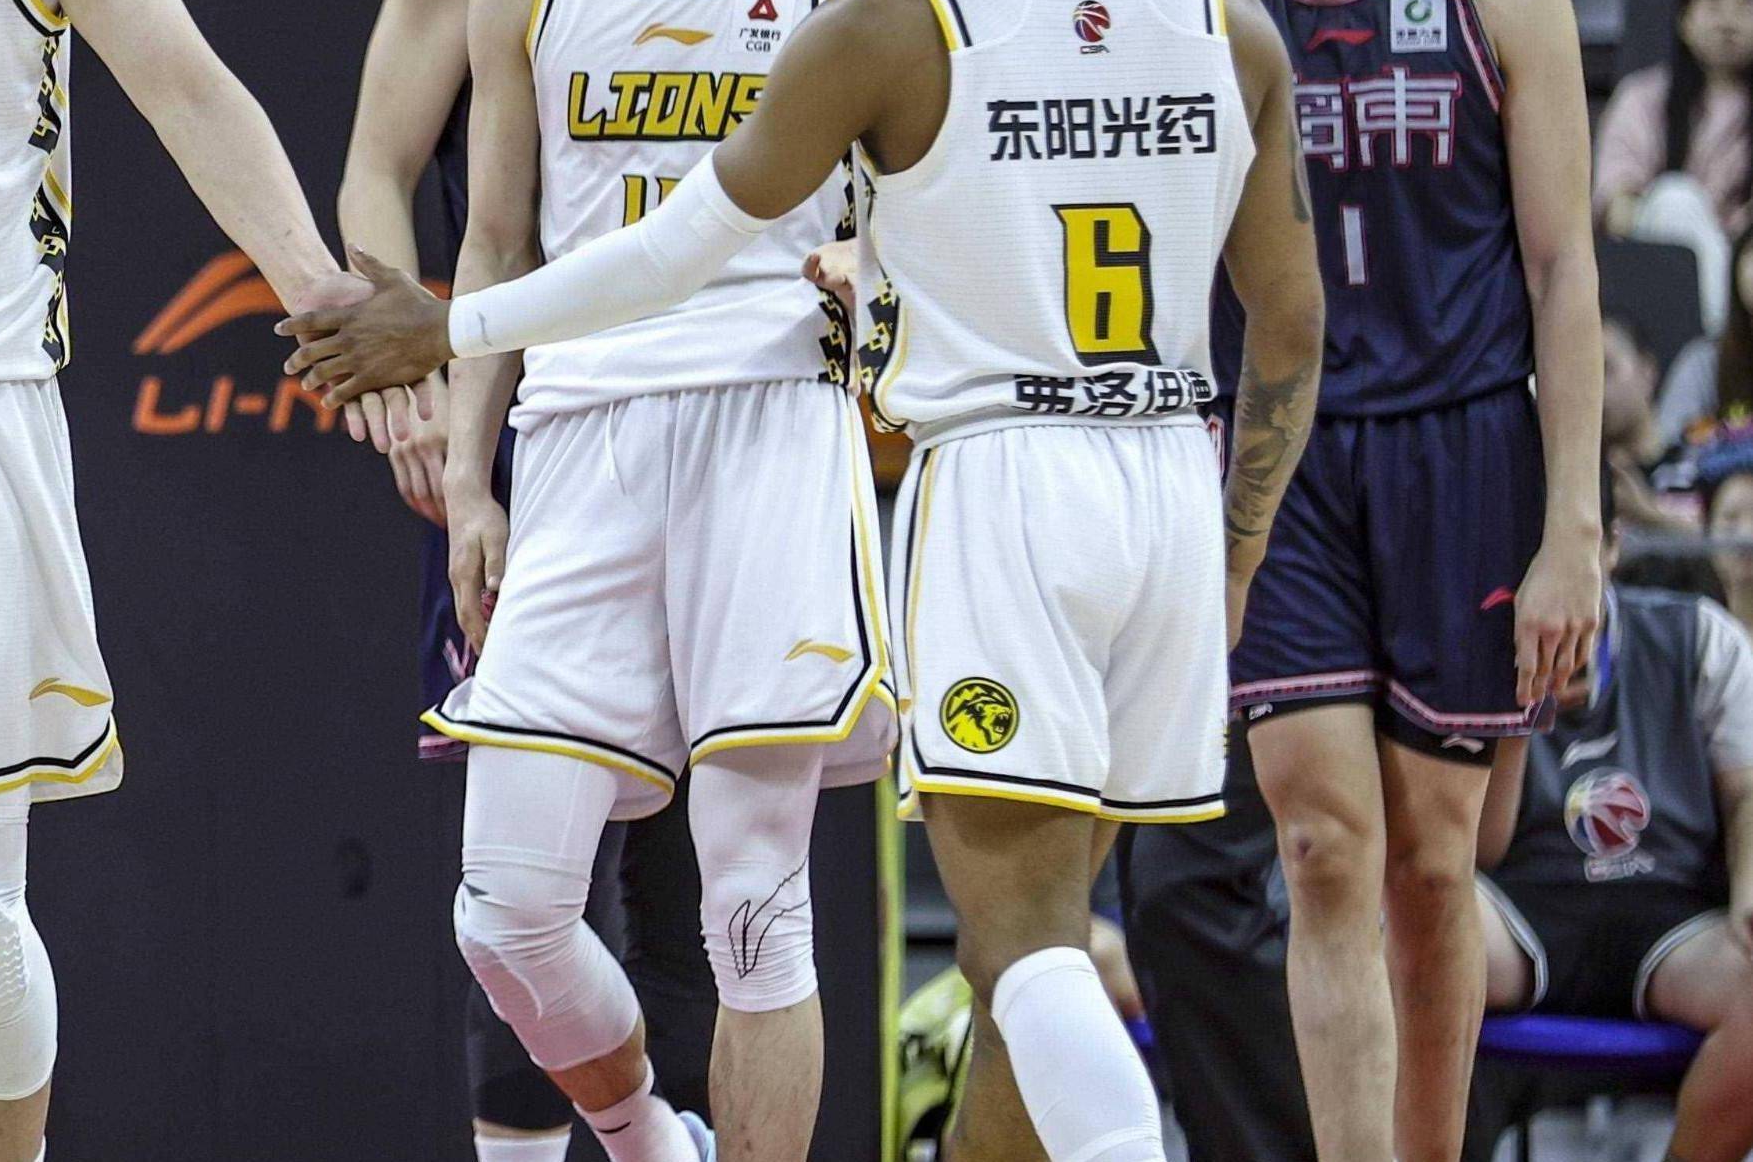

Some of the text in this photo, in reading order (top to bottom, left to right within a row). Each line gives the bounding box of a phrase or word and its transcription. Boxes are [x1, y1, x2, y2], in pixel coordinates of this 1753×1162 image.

[987, 92, 1217, 161] 东阳光药
[622, 174, 680, 228] 1
[1050, 202, 1162, 366] 6
[132, 374, 349, 435] LI-N
